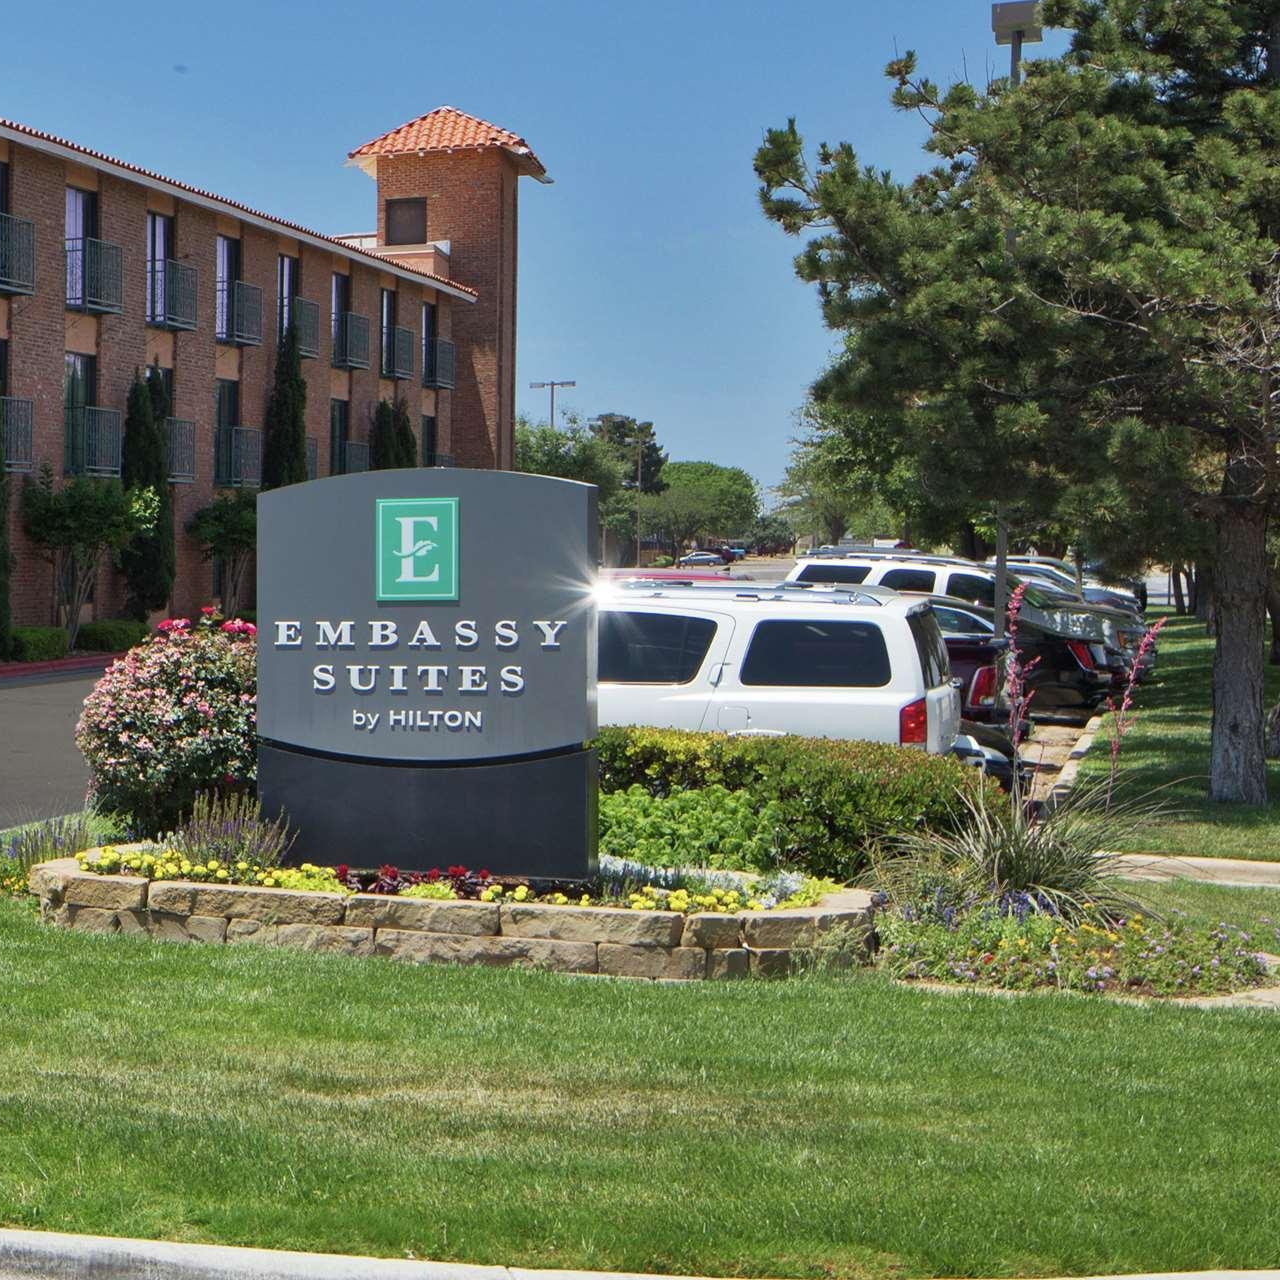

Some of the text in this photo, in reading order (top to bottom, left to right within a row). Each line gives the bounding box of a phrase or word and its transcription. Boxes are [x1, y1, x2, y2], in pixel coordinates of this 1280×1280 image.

[393, 516, 439, 583] E
[274, 620, 567, 647] EMBASSY
[313, 664, 525, 692] SUITES
[352, 709, 482, 729] by HILTON
